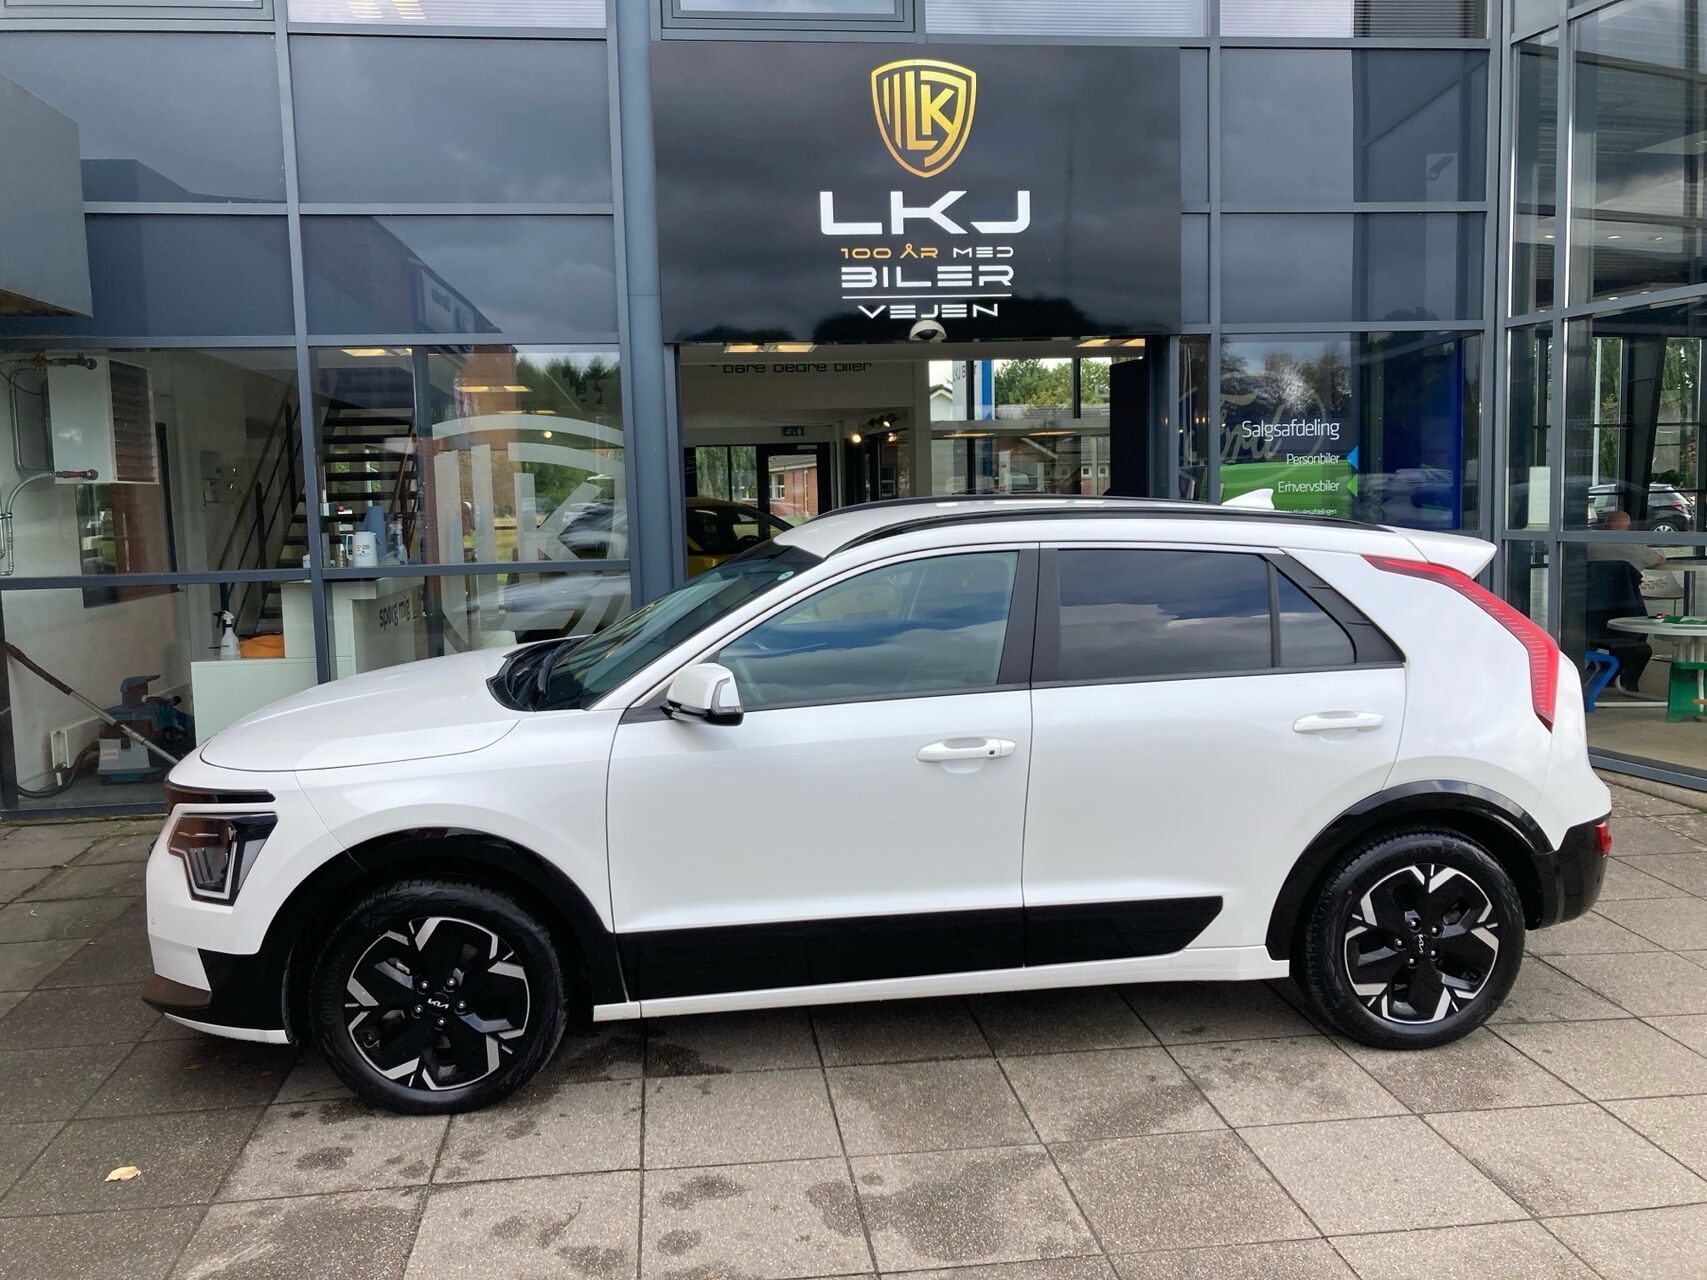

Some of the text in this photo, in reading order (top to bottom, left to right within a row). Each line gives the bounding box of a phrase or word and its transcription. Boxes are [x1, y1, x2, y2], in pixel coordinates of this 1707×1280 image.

[819, 190, 1031, 235] LKJ
[841, 242, 1014, 259] 100 ÅR MED
[841, 265, 1015, 288] BILER
[857, 303, 999, 319] VEJEN
[1241, 419, 1340, 442] Salgsafdeling
[1286, 452, 1340, 466] Personbiler
[1278, 480, 1340, 494] Erhvervsbiler
